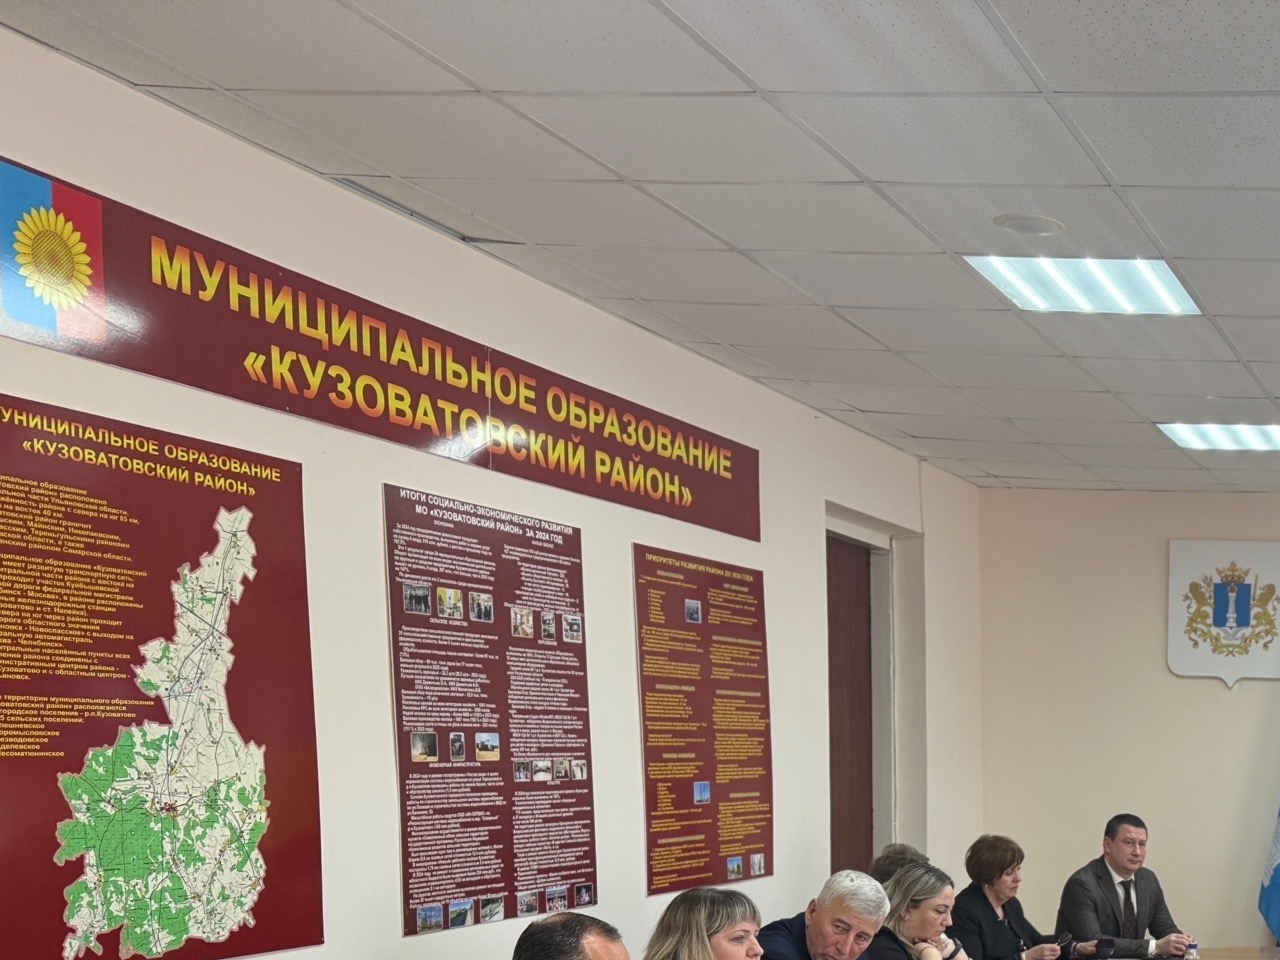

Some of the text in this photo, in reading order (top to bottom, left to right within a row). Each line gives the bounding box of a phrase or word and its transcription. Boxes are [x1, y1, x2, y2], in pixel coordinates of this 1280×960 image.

[150, 235, 732, 481] МУНИЦИПАЛЬНОЕ ОБРАЗОВАНИЕ
[242, 345, 693, 511] «КУЗОВАТОВСКИЙ РАЙОН»
[22, 437, 256, 497] «КУЗОВАТОВСКИЙ РАЙОН»
[164, 443, 281, 483] ОБРАЗОВАНИЕ
[40, 481, 87, 495] образование
[28, 494, 49, 502] части
[52, 496, 97, 510] Ульяновской
[31, 487, 58, 497] район»
[60, 492, 107, 505] расположено
[16, 506, 40, 515] восток
[39, 502, 65, 512] района
[73, 508, 98, 518] севера
[400, 488, 573, 535] ИТОГИ СОЦИАЛЬНО-ЭКОНОМИЧЕСКОГО РАЗВИТИЯ
[27, 520, 66, 534] Майнским,
[35, 515, 58, 524] район
[60, 519, 92, 530] граничит
[415, 504, 428, 515] МО
[430, 508, 495, 529] «КУЗОВАТОВСКИЙ
[496, 521, 523, 535] РАЙОН»
[525, 528, 535, 537] ЗА
[535, 530, 550, 541] 2024
[550, 532, 563, 545] ГОД
[28, 542, 60, 552] районом
[62, 545, 102, 557] Самарской
[64, 541, 84, 549] также
[96, 539, 130, 549] районами
[0, 553, 42, 564] ципальное
[45, 558, 91, 570] образование
[2, 560, 26, 568] имеет
[28, 563, 64, 574] развитую
[66, 568, 116, 581] транспортную
[36, 578, 64, 587] участок
[66, 580, 120, 593] Куйбышевской
[42, 572, 62, 580] части
[64, 575, 90, 583] района
[98, 579, 124, 587] востока
[14, 583, 134, 601] дороги федеральной магистрали
[18, 597, 116, 614] железнодорожные станции
[70, 595, 94, 604] районе
[96, 599, 143, 609] расположены
[23, 617, 66, 627] областного
[68, 623, 100, 631] значения
[44, 613, 65, 622] через
[66, 615, 88, 623] район
[90, 618, 122, 627] проходит
[34, 634, 93, 645] автомагистраль
[92, 631, 124, 640] выходом
[23, 652, 50, 660] района
[52, 655, 92, 664] соединены
[42, 648, 86, 656] населённые
[88, 651, 114, 659] пункты
[55, 668, 96, 677] областным
[98, 672, 126, 680] центром
[58, 663, 88, 671] центром
[90, 664, 114, 672] района
[4, 695, 48, 703] территории
[111, 697, 154, 706] образования
[46, 702, 72, 710] район»
